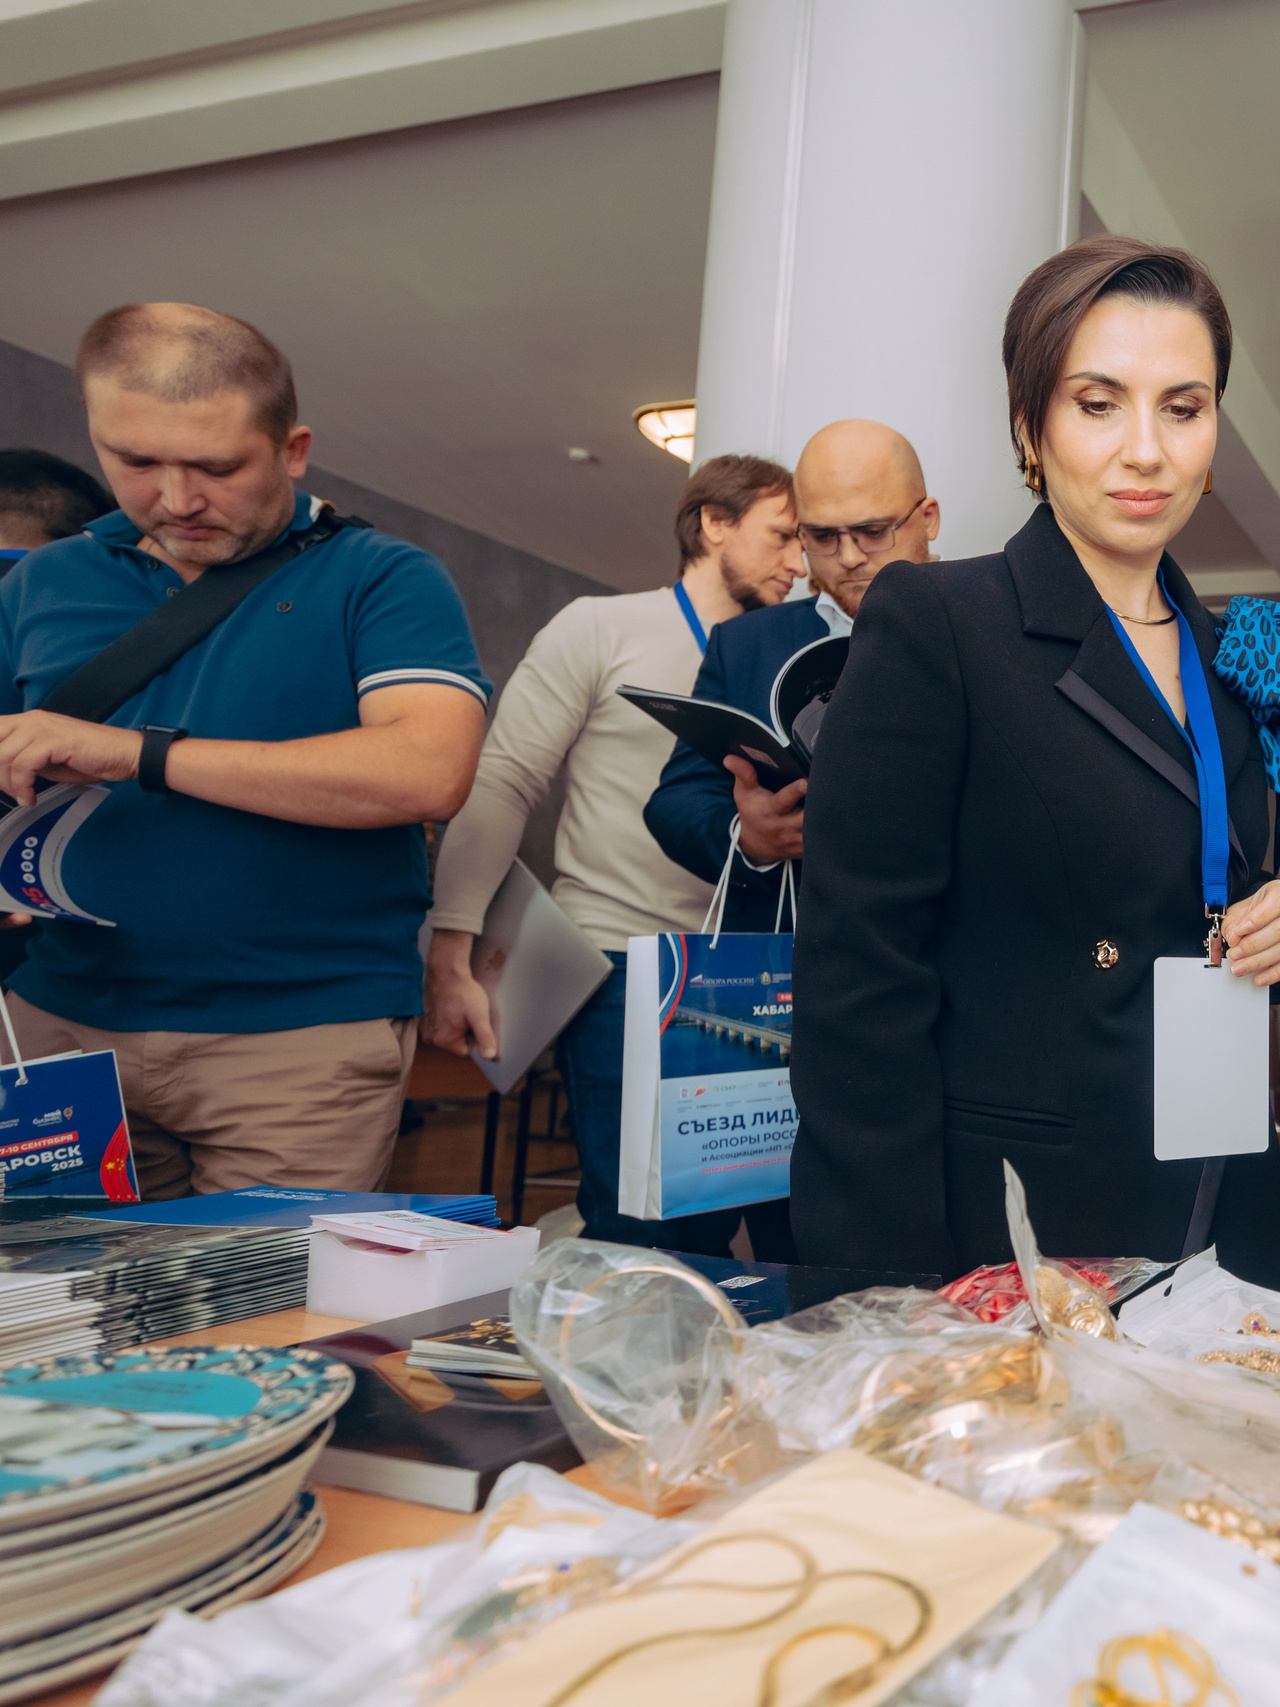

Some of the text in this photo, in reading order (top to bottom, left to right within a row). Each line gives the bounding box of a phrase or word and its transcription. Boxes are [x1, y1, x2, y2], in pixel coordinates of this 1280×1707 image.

[702, 977, 755, 986] ОПОРА РОССИИ
[677, 1114, 746, 1136] СЪЕЗД
[20, 1133, 74, 1151] СЕНТЯБРЯ
[701, 1133, 760, 1151] «ОПОРЫ
[709, 1147, 764, 1161] Ассоциации
[51, 1157, 84, 1172] 2025
